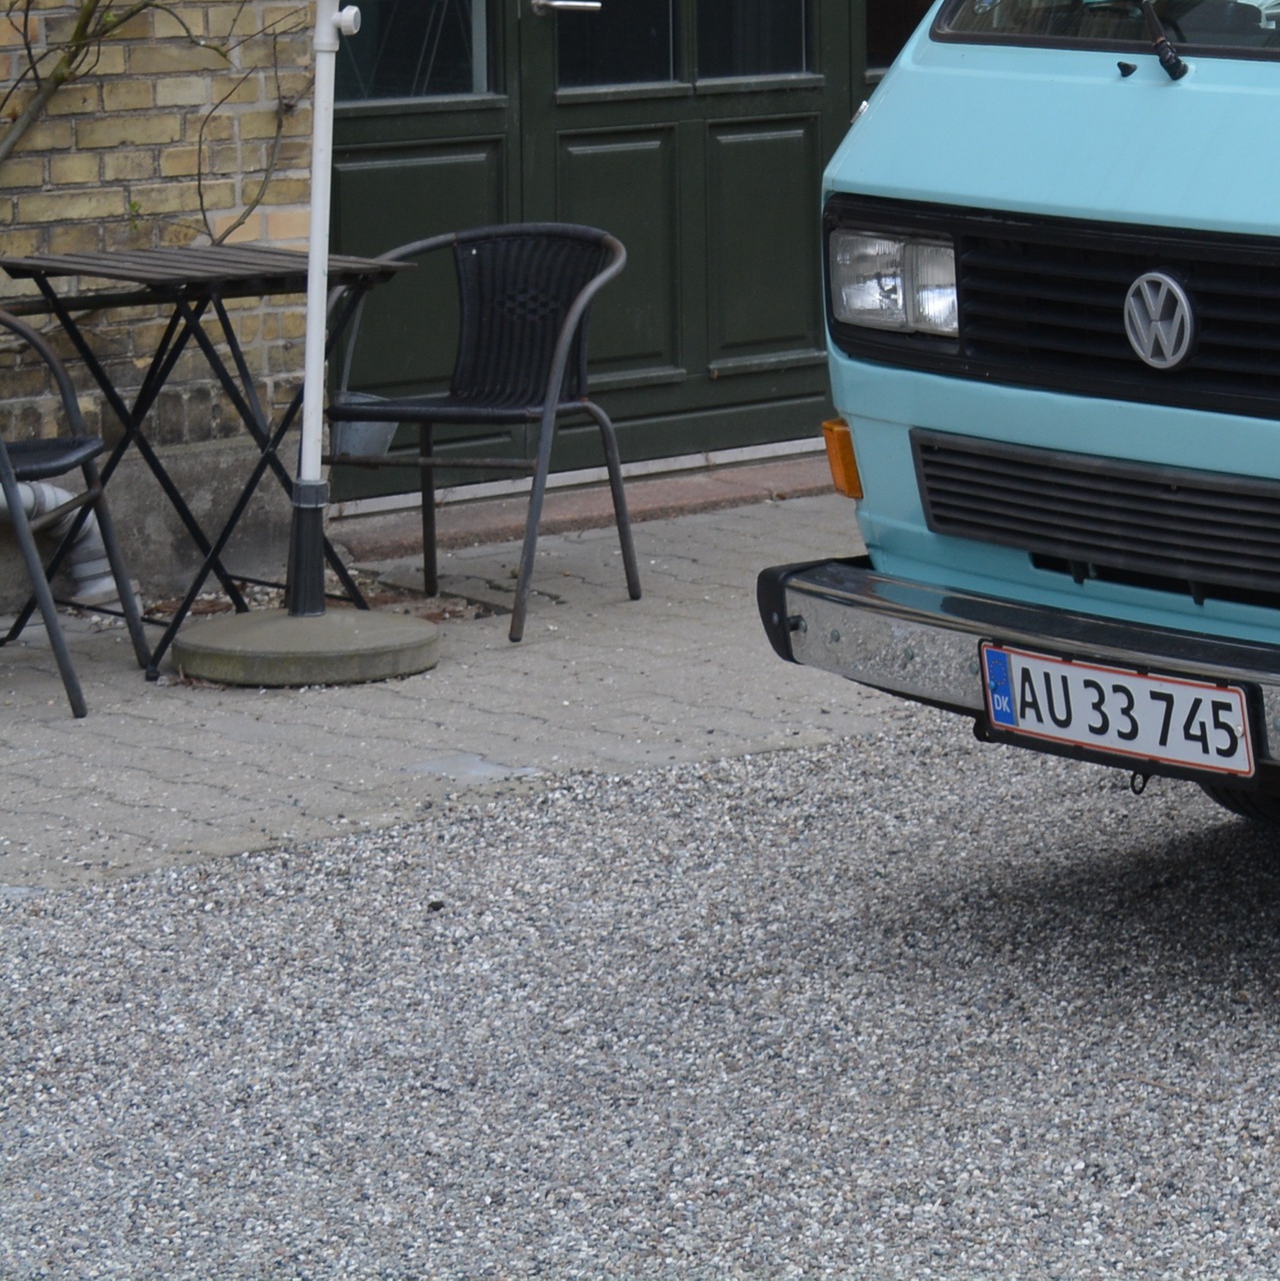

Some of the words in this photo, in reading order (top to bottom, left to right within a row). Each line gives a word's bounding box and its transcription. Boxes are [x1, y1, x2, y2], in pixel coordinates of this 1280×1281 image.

[1125, 273, 1190, 368] VW
[993, 694, 1012, 714] DK
[1020, 667, 1072, 729] AU
[1083, 679, 1139, 741] 33
[1150, 690, 1239, 758] 745
